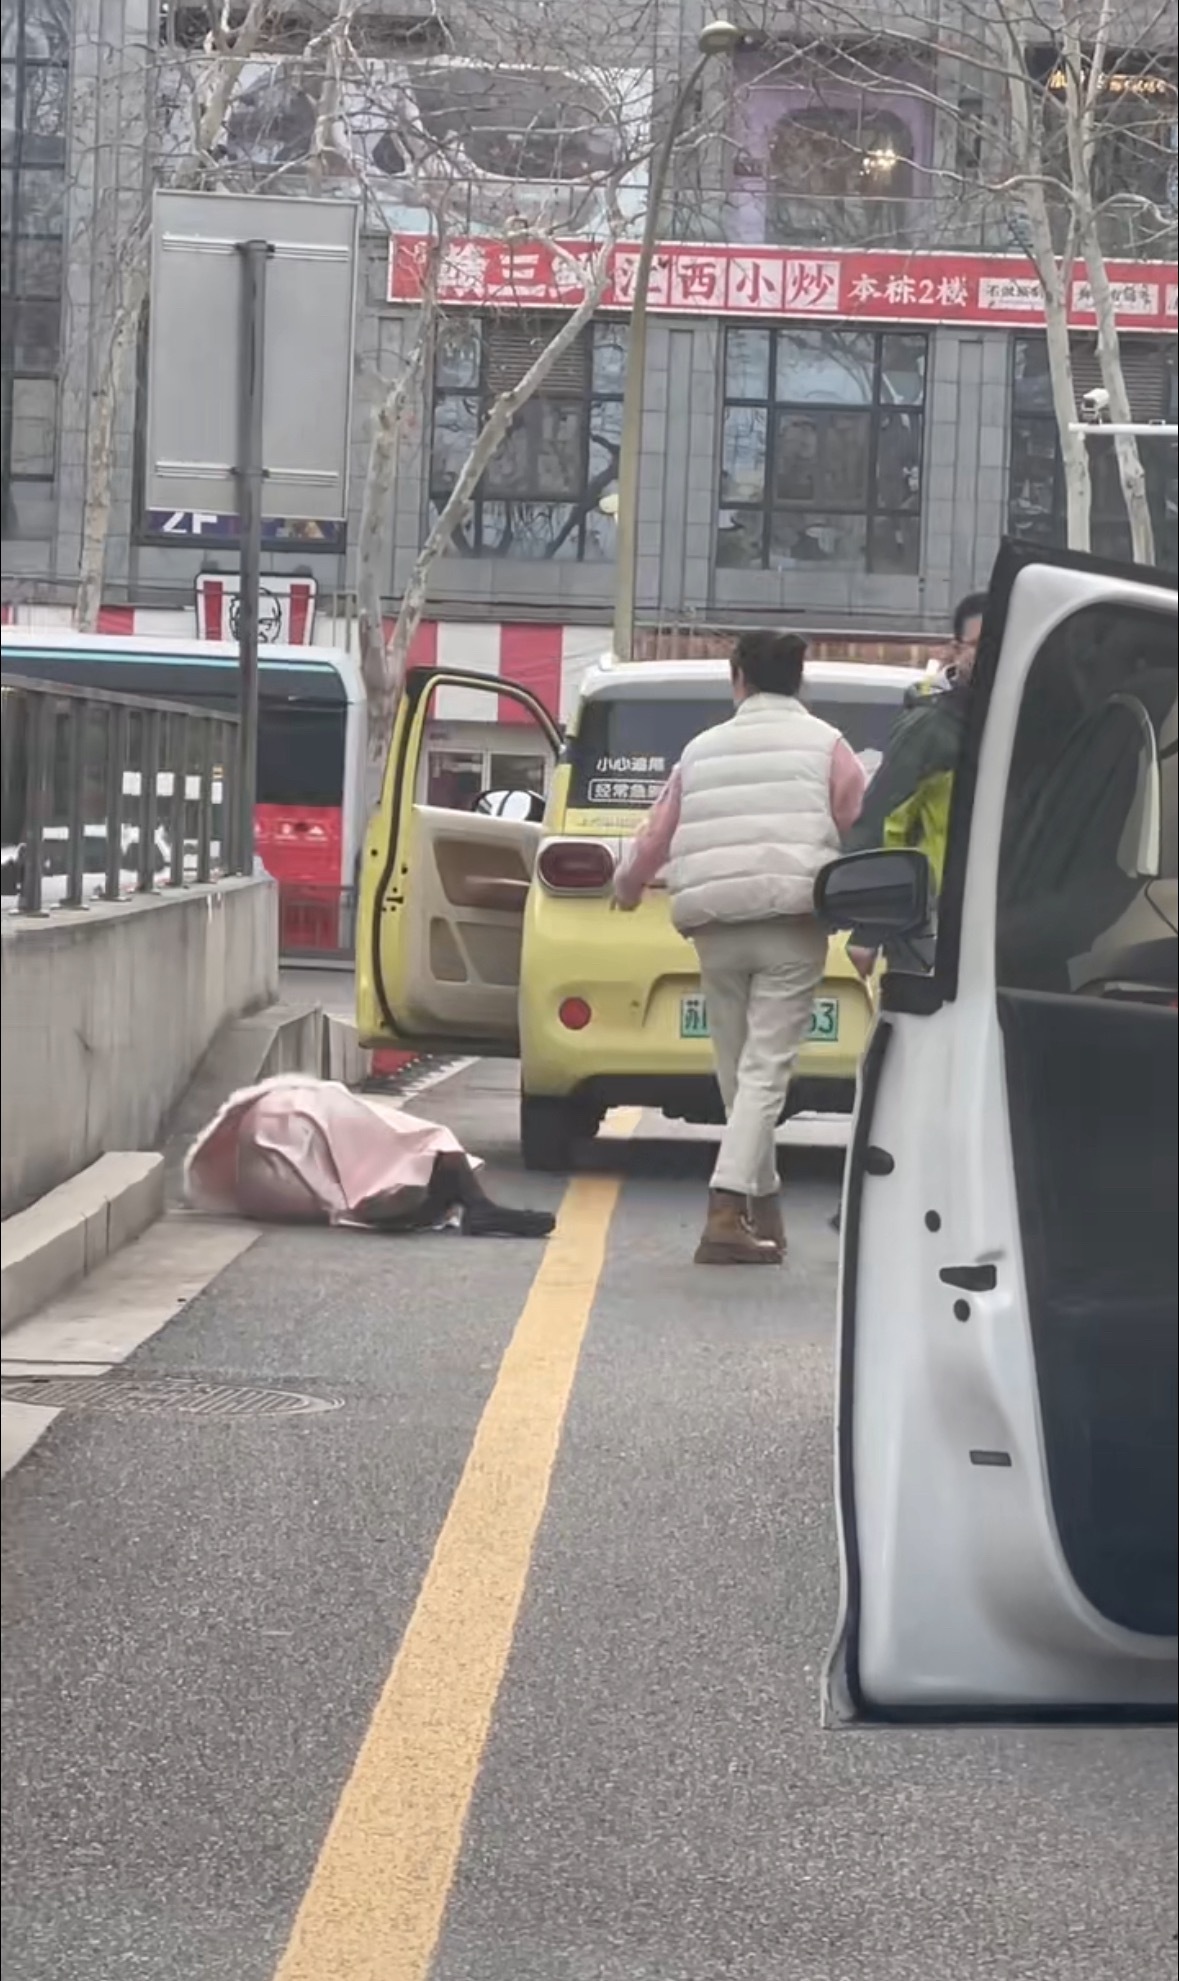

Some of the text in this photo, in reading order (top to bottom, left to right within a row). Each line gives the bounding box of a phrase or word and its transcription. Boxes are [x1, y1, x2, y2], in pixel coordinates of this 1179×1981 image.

[847, 273, 968, 307] 本栋2楼
[596, 756, 665, 772] 小心追尾
